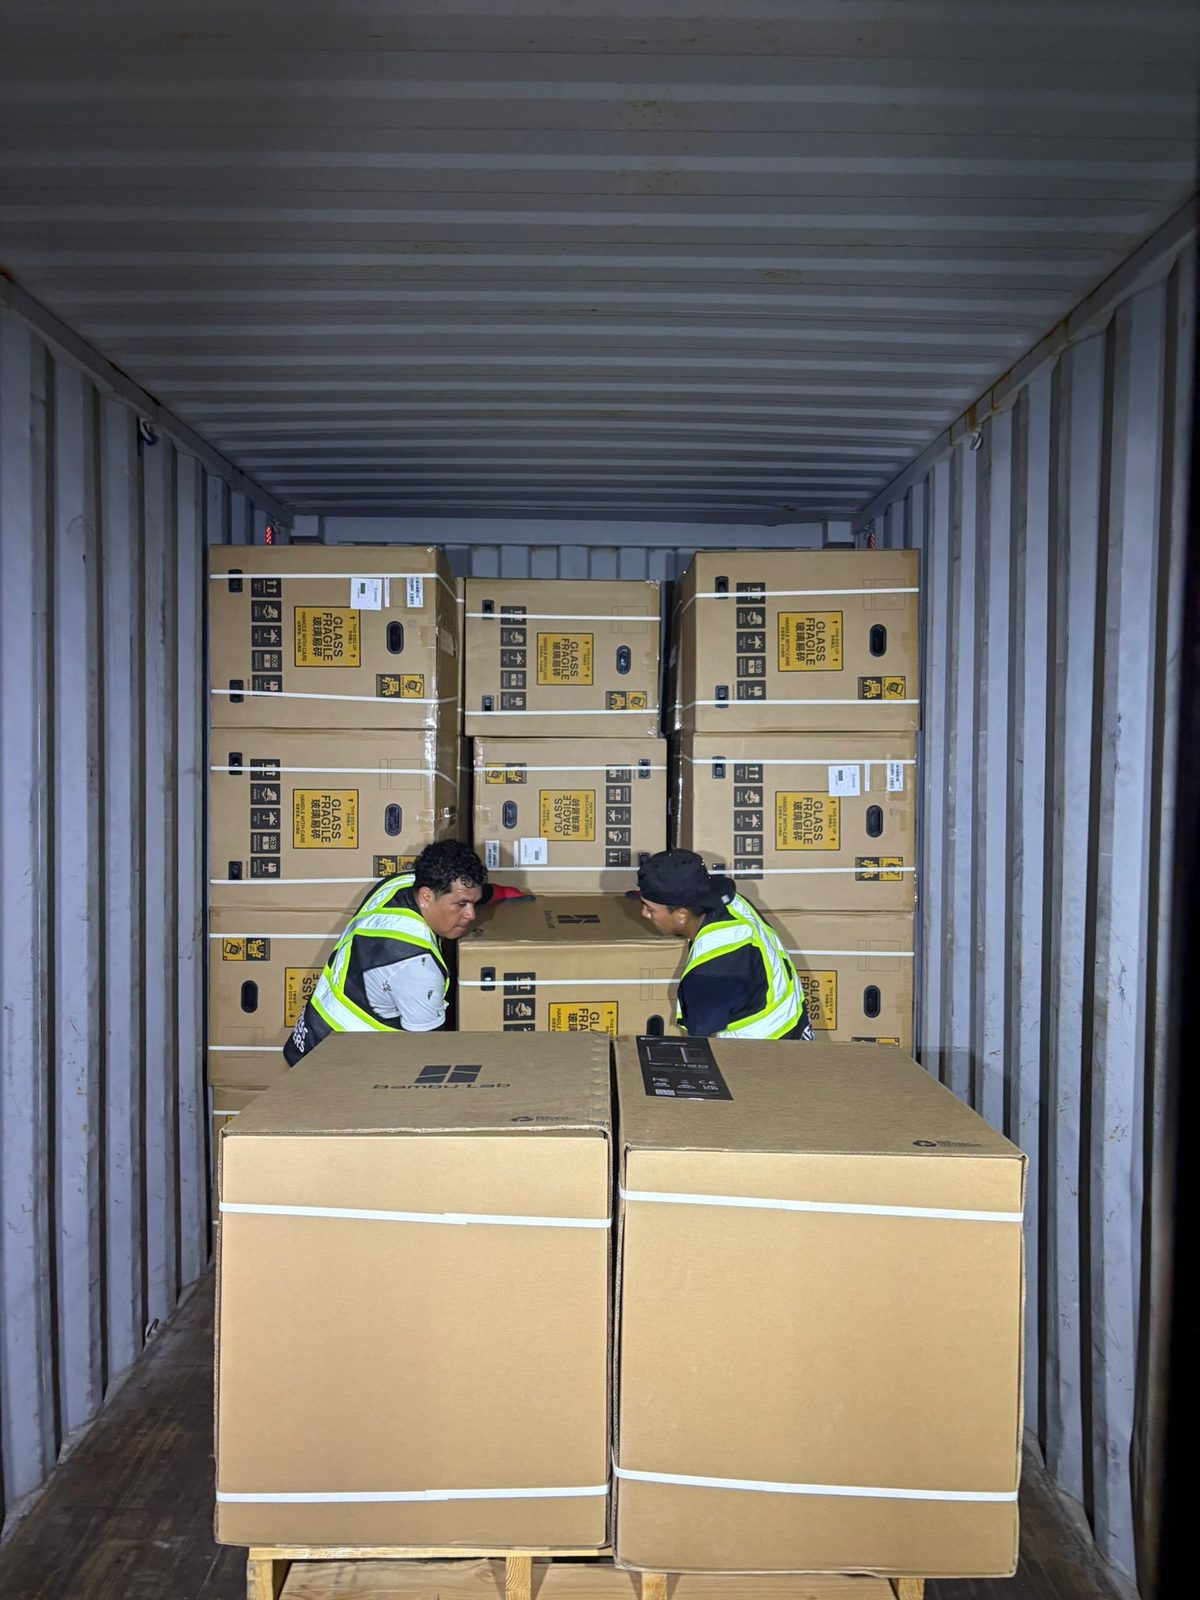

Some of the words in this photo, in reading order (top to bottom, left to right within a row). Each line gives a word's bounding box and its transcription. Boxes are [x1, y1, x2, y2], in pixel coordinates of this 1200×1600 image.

[312, 617, 322, 656] 玻璃易碎
[323, 613, 332, 661] FRAGILE
[334, 616, 343, 657] GLASS
[806, 618, 815, 665] FRAGILE
[816, 621, 825, 661] GLASS
[561, 639, 569, 680] FRAGILE
[310, 799, 320, 839] 玻璃易碎
[321, 796, 330, 843] FRAGILE
[332, 799, 341, 839] GLASS
[563, 795, 571, 835] FRAGILE
[803, 797, 812, 845] FRAGILE
[814, 801, 823, 841] GLASS
[810, 980, 819, 1020] GLASS
